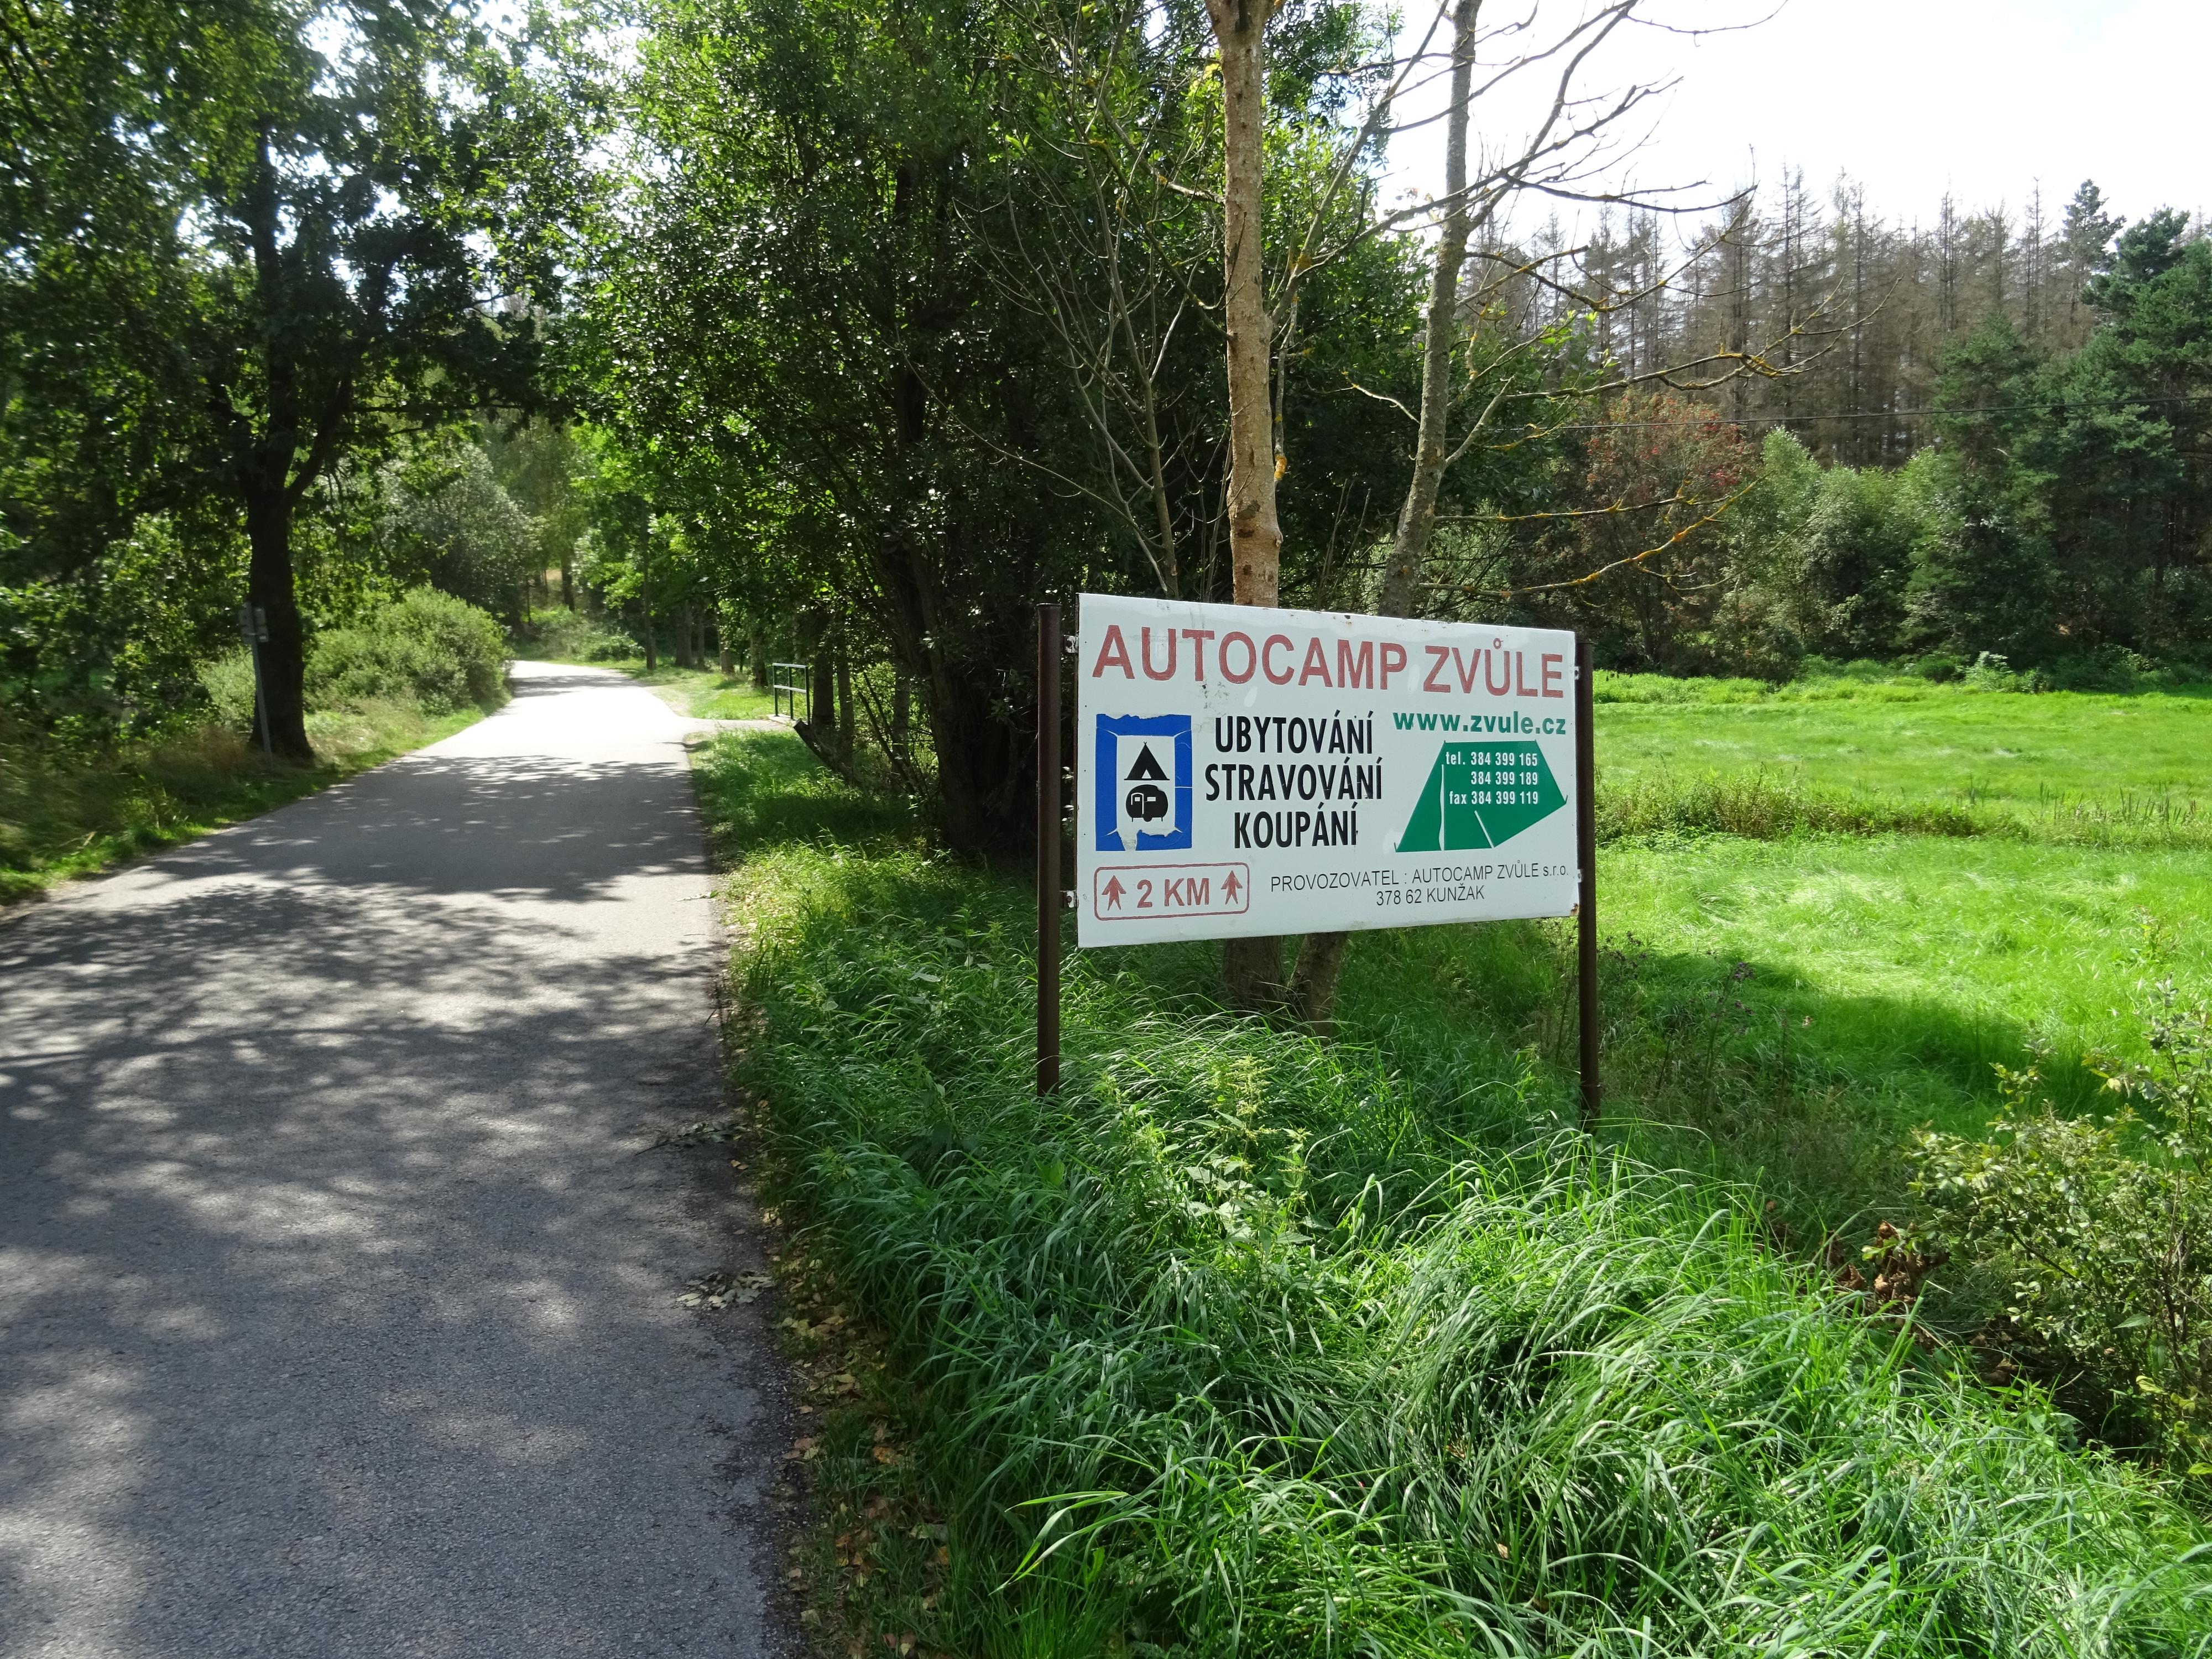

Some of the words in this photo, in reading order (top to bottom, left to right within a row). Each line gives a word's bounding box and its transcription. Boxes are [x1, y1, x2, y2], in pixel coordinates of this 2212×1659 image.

[1092, 624, 1407, 690] AUTOCAMP
[1423, 638, 1563, 698] ZVŮLE
[1215, 709, 1374, 754] UBYTOVÁNÍ
[1392, 711, 1566, 734] www.zvule.cz
[1446, 752, 1465, 765] tel.
[1470, 752, 1491, 765] 384
[1495, 752, 1515, 766] 399
[1519, 753, 1537, 766] 165
[1204, 756, 1383, 801] STRAVOVÁNÍ
[1471, 771, 1491, 785] 384
[1495, 771, 1515, 785] 399
[1519, 772, 1538, 785] 189
[1449, 791, 1467, 804] fax
[1471, 791, 1491, 805] 384
[1496, 791, 1515, 805] 399
[1520, 791, 1538, 805] 119
[1234, 801, 1358, 849] KOUPÁNÍ
[1271, 870, 1399, 892] PROVOZOVATEL
[1412, 865, 1493, 884] AUTOCAMP
[1497, 859, 1539, 879] ZVŮLE
[1543, 865, 1569, 877] s.r.o.
[1136, 879, 1152, 908] 2
[1164, 878, 1209, 907] KM
[1376, 890, 1401, 906] 378
[1405, 889, 1422, 904] 62
[1427, 882, 1484, 902] KUNŽAK
